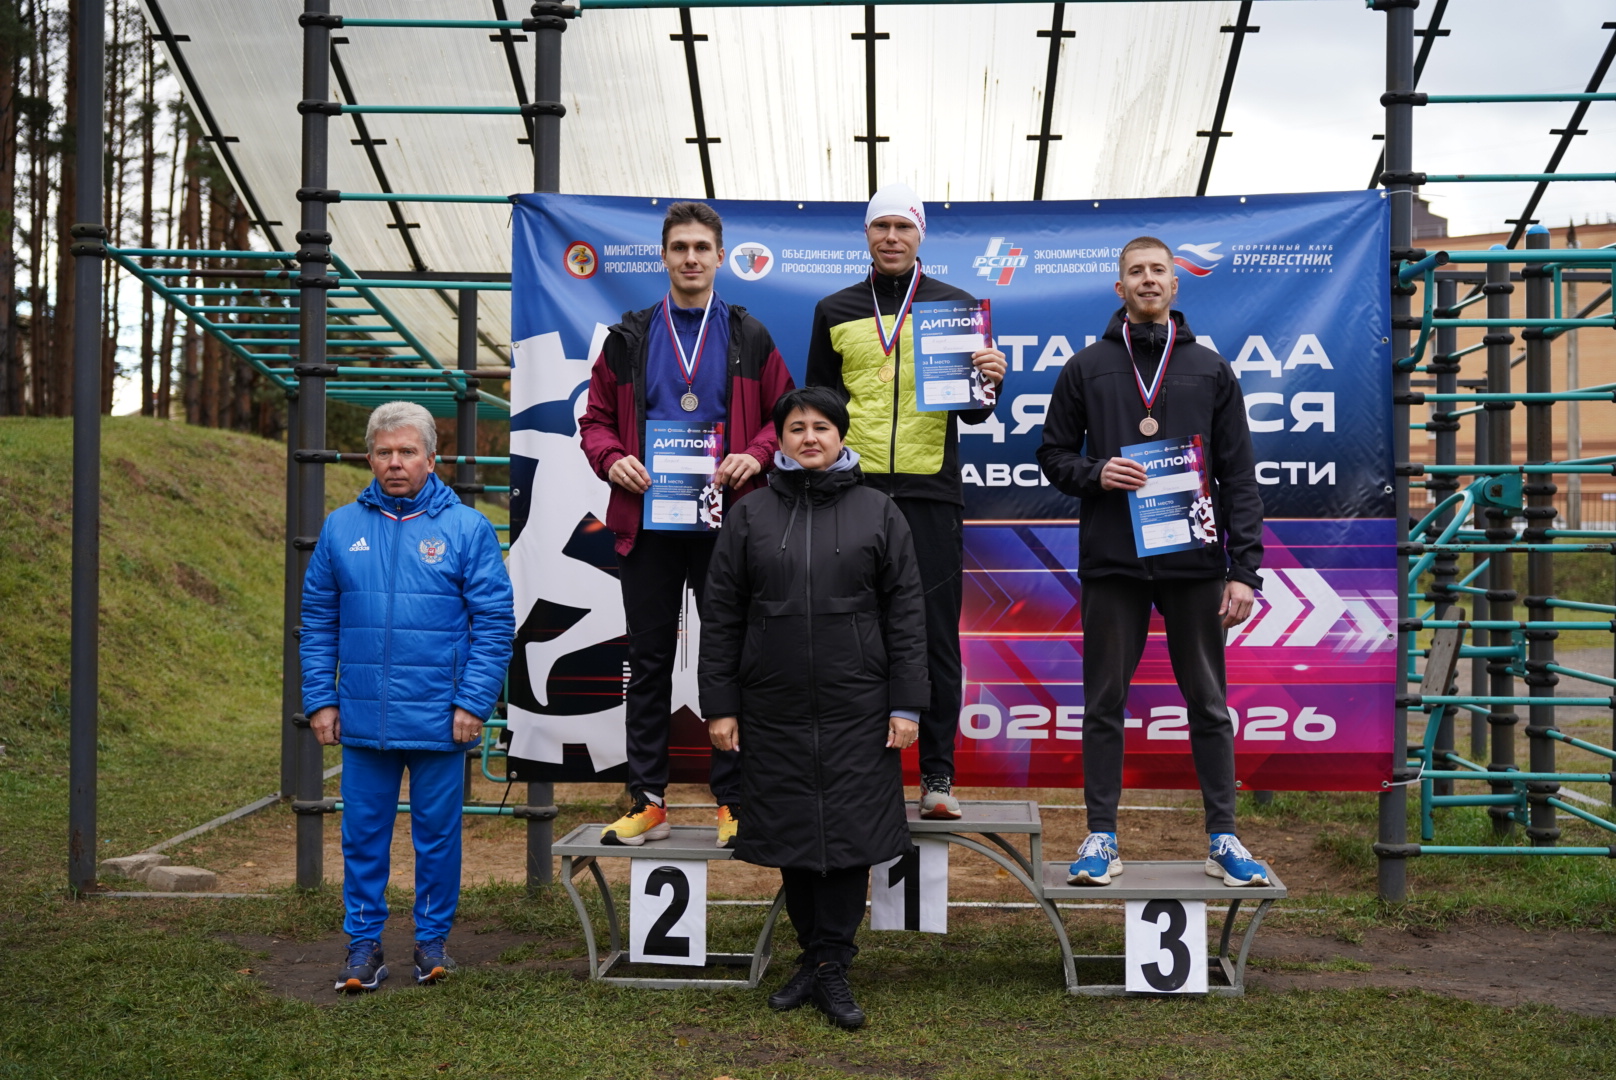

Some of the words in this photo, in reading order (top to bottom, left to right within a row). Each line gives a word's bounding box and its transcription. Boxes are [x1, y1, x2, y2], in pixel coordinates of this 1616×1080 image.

[604, 244, 664, 256] МИНИСТЕРСТ
[781, 249, 845, 260] ОБЪЕДИНЕНИЕ
[1034, 247, 1110, 259] ЭКОНОМИЧЕСКИЙ
[974, 256, 1027, 267] РСПП
[1232, 254, 1333, 266] БУРЕВЕСТНИК
[604, 260, 665, 273] ЯРОСЛАВСКОЙ
[781, 263, 842, 273] ПРОФСОЮЗОВ
[1034, 262, 1098, 274] ЯРОСЛАВСКОЙ
[920, 317, 984, 330] ДИПЛОМ
[653, 438, 716, 449] ДИПЛОМ
[1143, 454, 1197, 471] ИПЛОМ
[888, 846, 920, 931] 1
[643, 865, 690, 957] 2
[1140, 898, 1191, 991] 3
